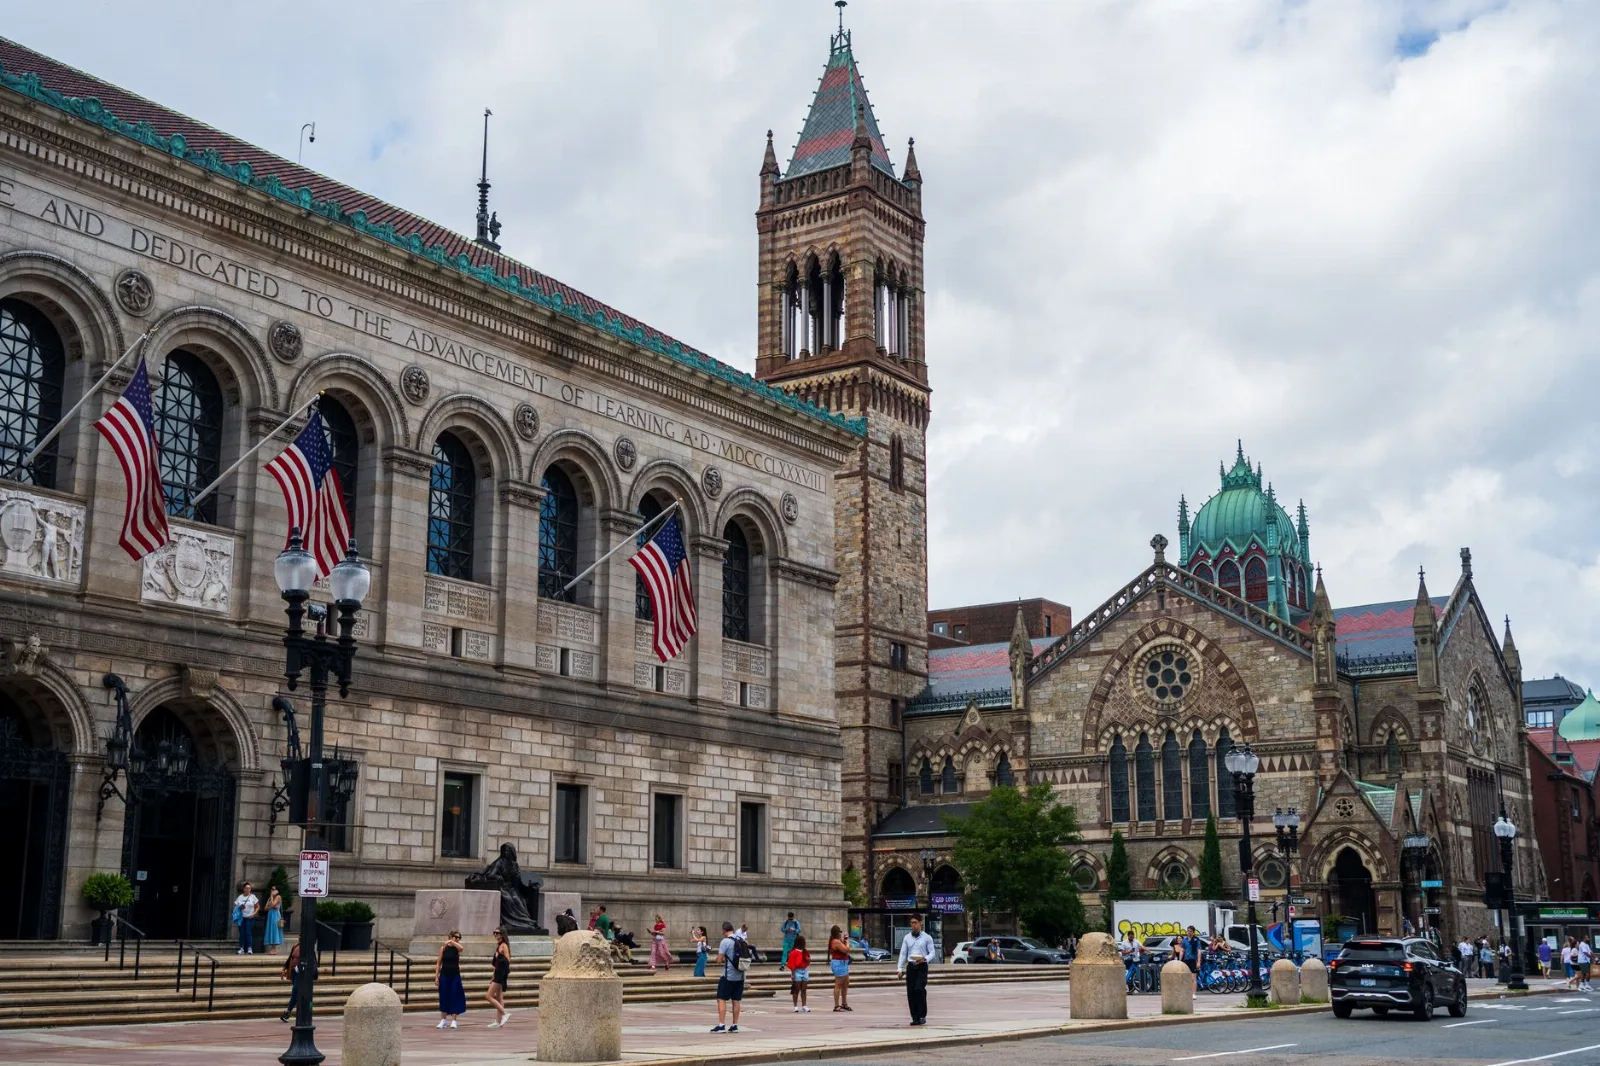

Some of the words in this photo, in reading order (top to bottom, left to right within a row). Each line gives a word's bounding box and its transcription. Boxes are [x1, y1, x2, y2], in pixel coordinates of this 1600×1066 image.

[41, 199, 104, 236] AND
[131, 228, 279, 299] DEDICATED
[301, 289, 333, 317] TO
[348, 306, 392, 340] THE
[405, 330, 548, 393] ADVANCEMENT
[561, 385, 584, 405] OF
[597, 396, 675, 439] LEARNING
[313, 853, 328, 861] ZONE
